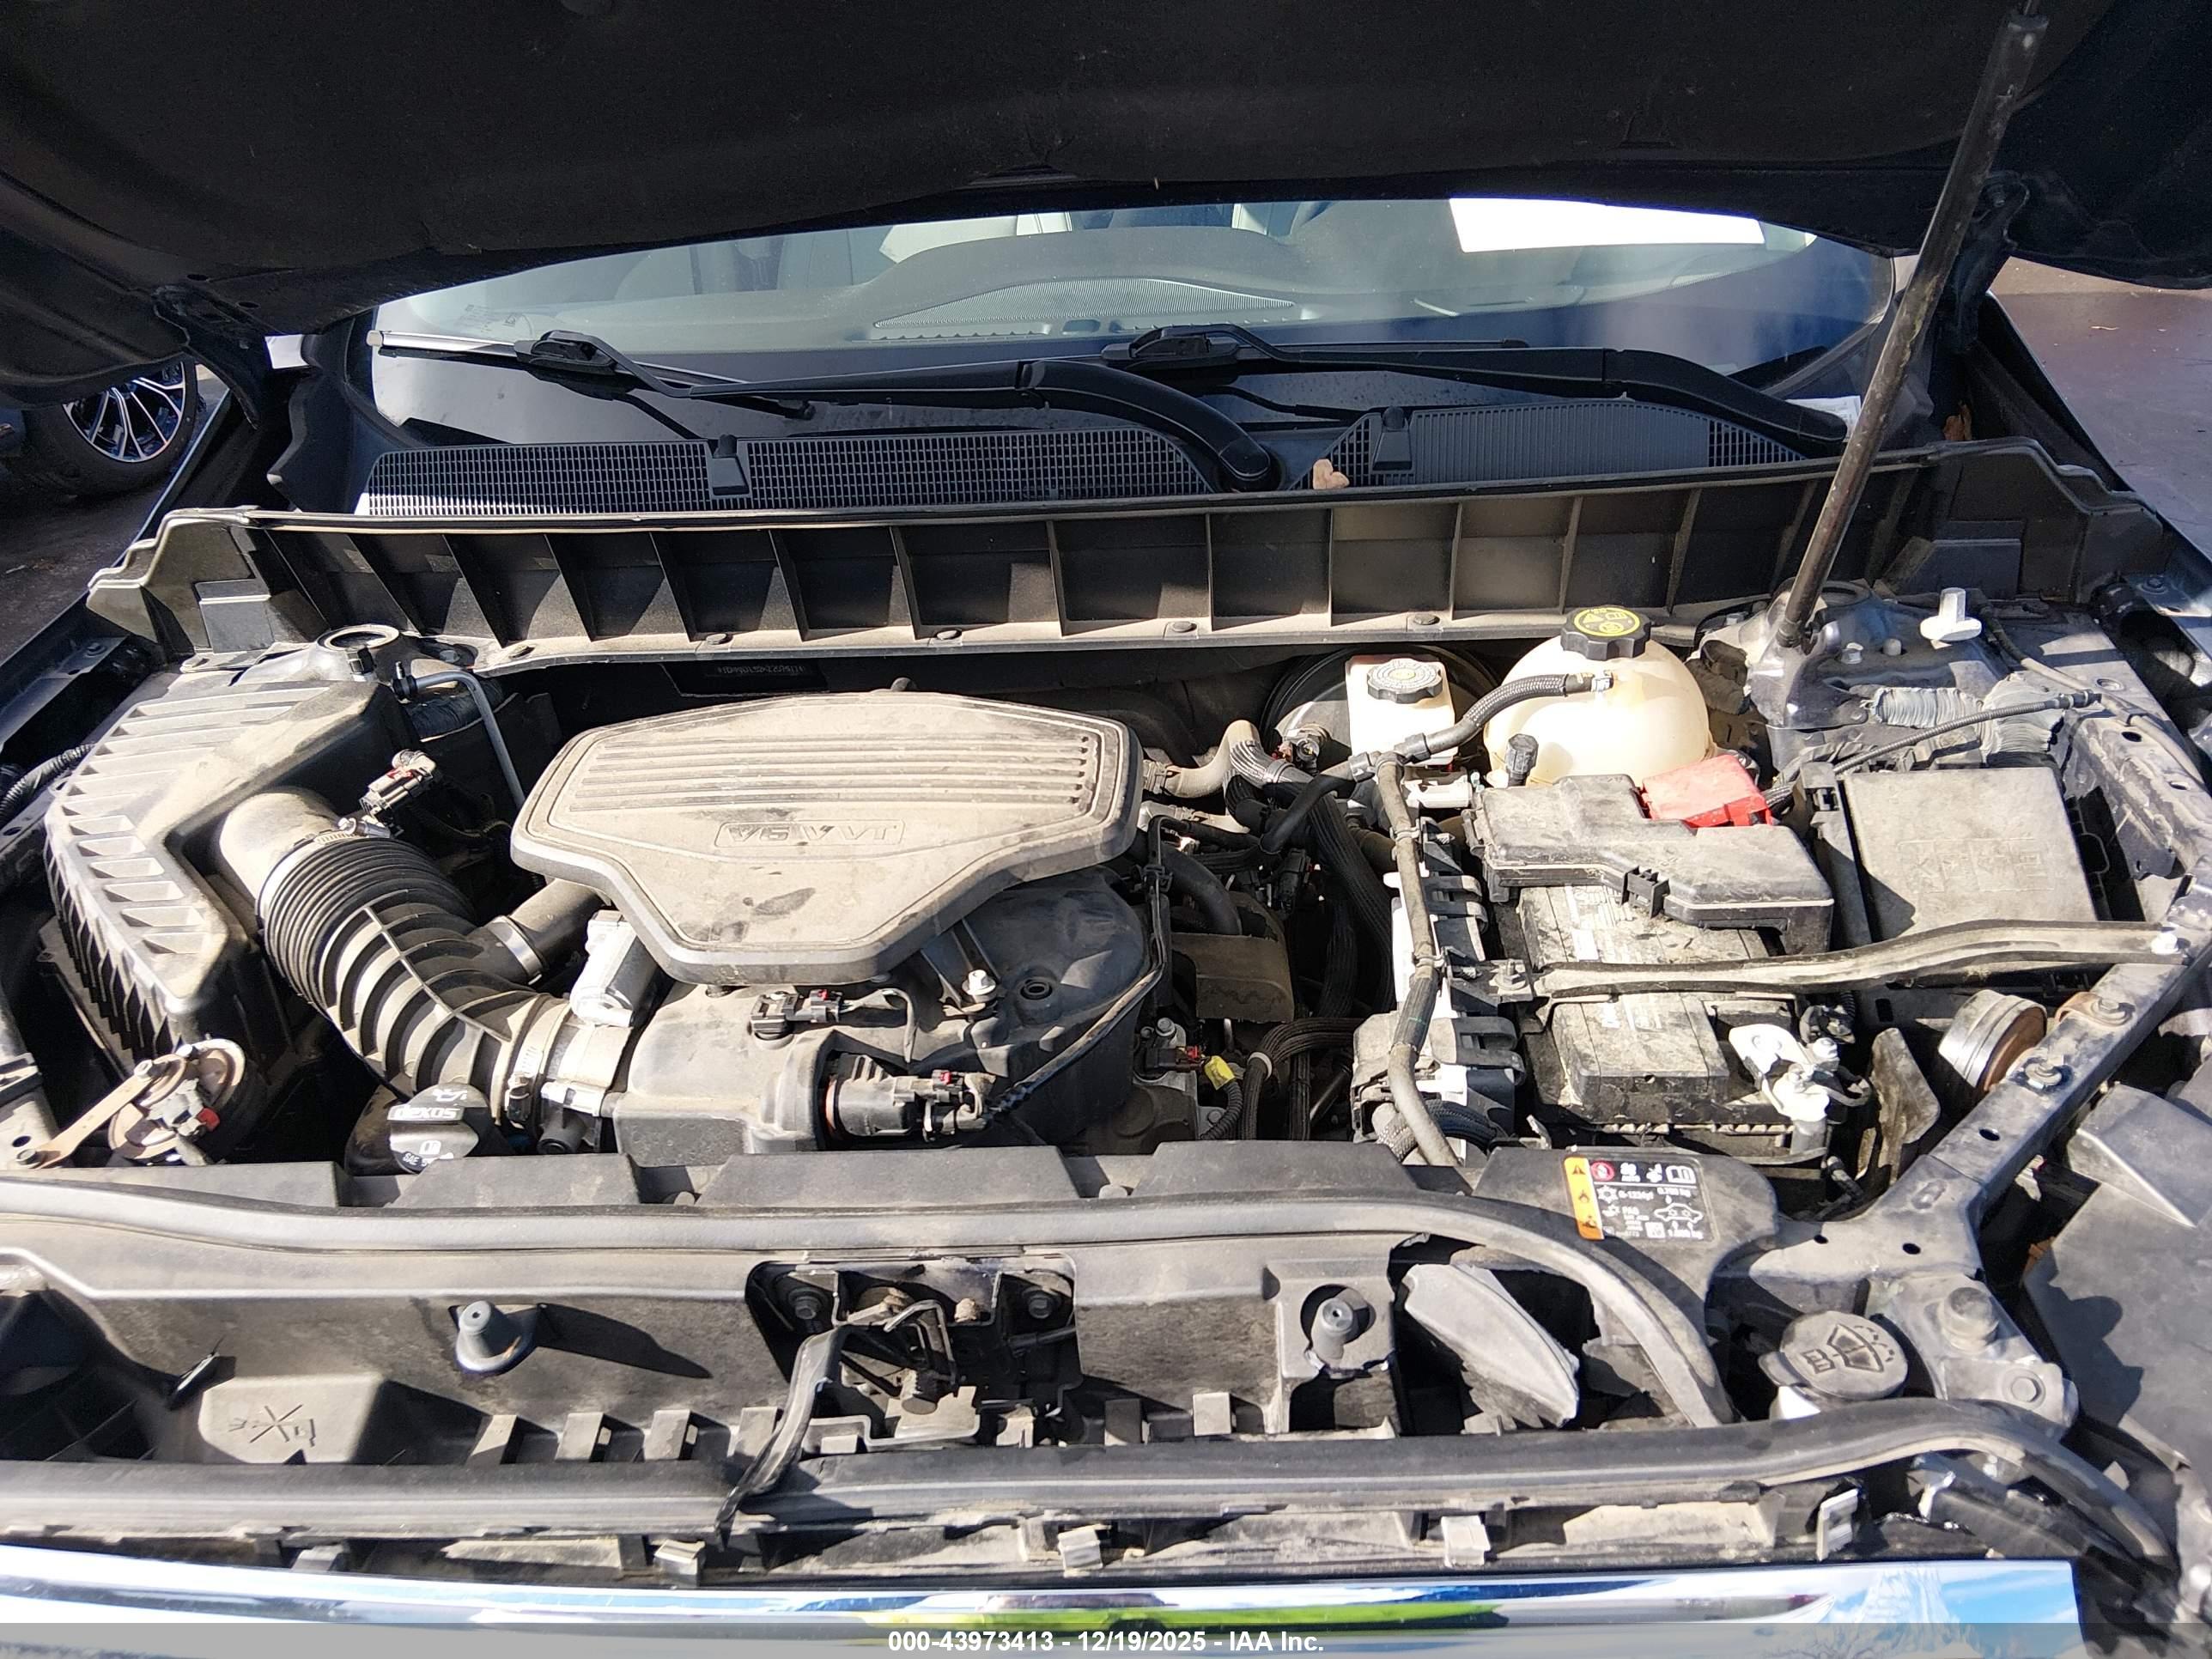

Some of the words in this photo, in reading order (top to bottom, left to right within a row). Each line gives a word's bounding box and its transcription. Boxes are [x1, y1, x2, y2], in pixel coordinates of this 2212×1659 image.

[727, 825, 791, 842] V6
[801, 824, 897, 842] VVT
[402, 1152, 420, 1166] SAE
